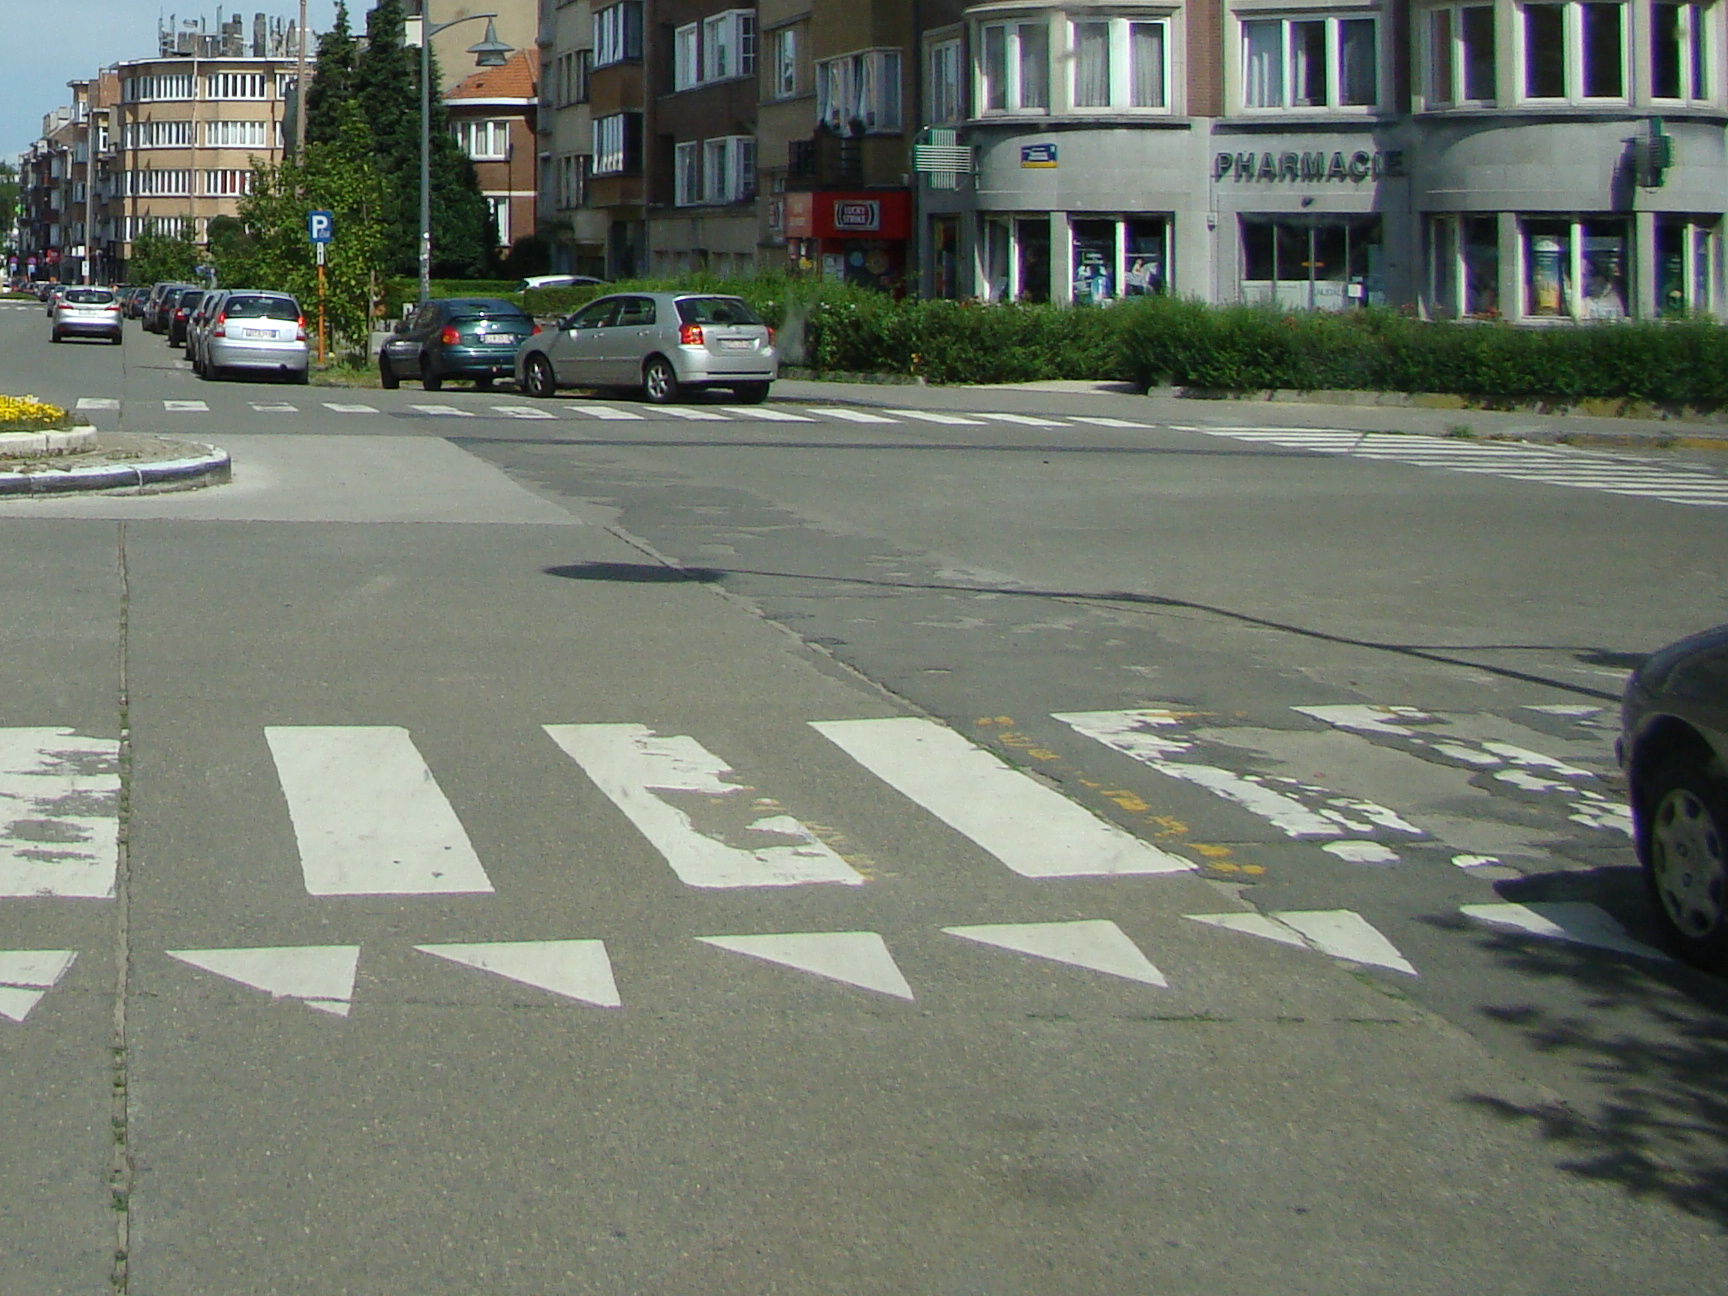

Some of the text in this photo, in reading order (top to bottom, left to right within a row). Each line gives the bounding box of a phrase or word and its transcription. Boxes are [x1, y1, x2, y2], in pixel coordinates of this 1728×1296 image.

[1214, 151, 1405, 182] PHARMACIE
[844, 206, 866, 215] LUCKY
[312, 215, 328, 238] P
[843, 215, 867, 223] STRIKE
